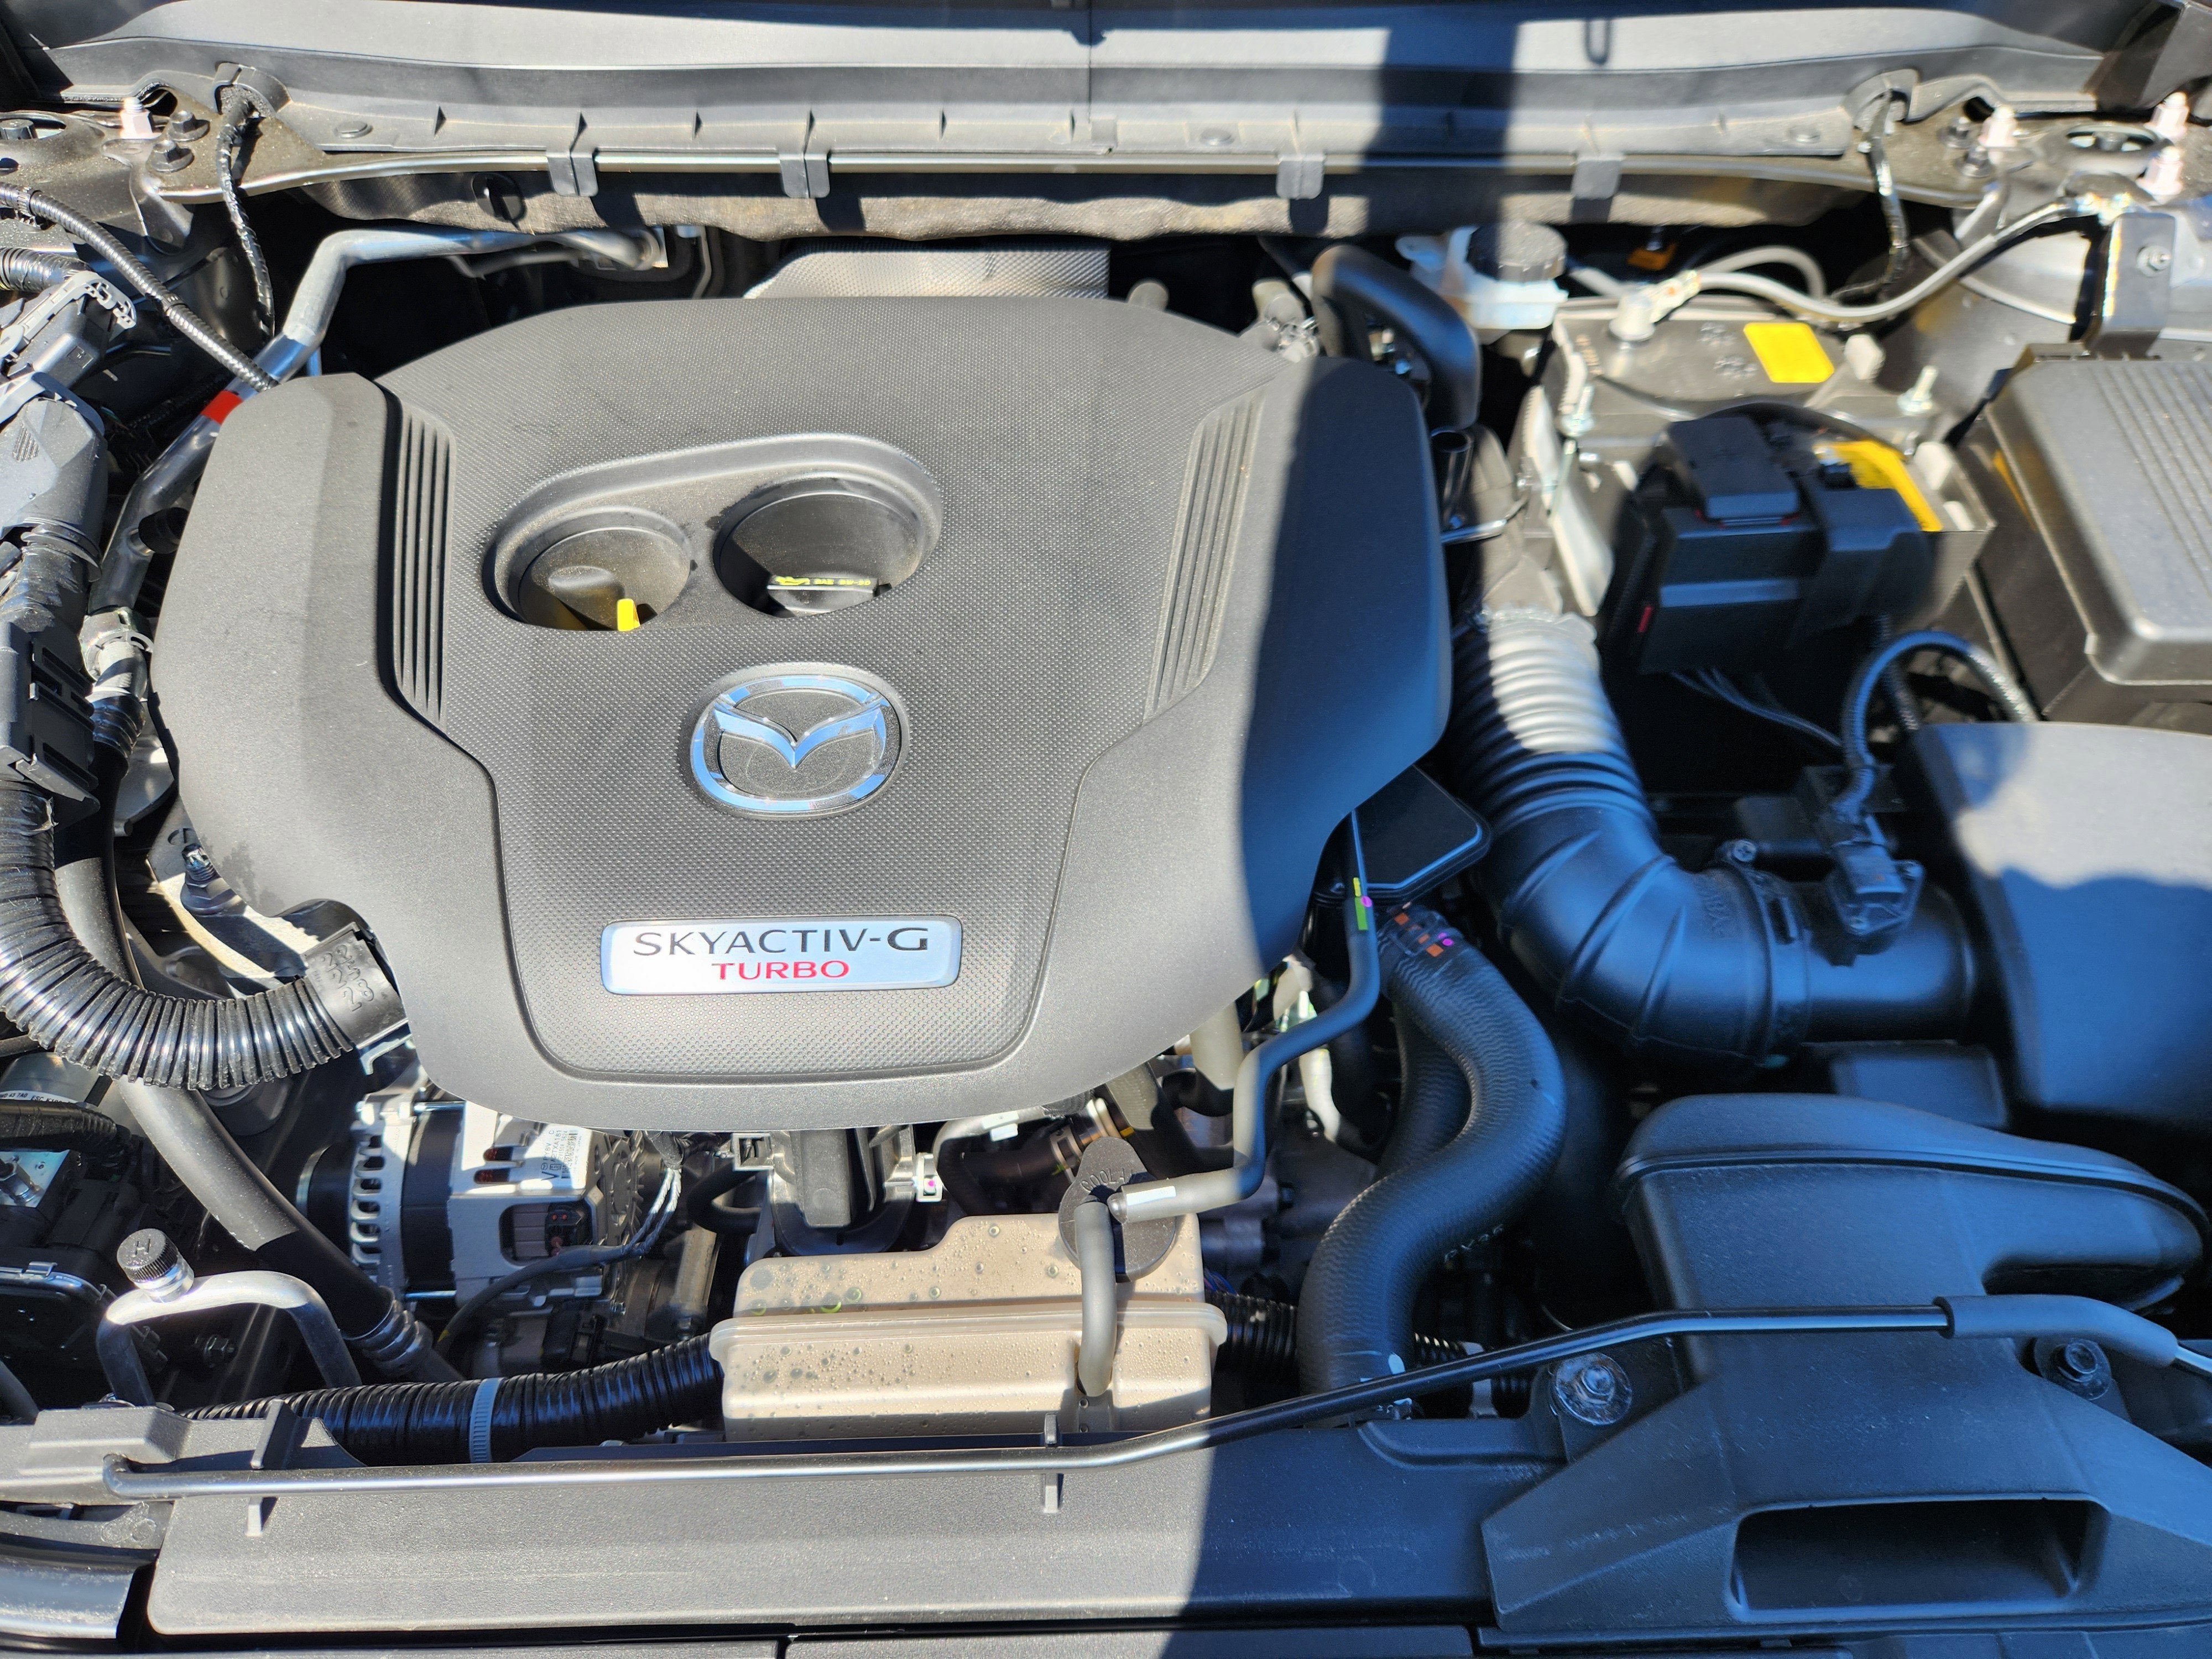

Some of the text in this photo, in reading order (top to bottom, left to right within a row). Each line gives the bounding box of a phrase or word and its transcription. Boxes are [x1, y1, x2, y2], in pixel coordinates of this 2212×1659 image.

[633, 927, 928, 956] SKYACTIV-G
[712, 960, 850, 981] TURBO
[132, 1238, 151, 1257] H
